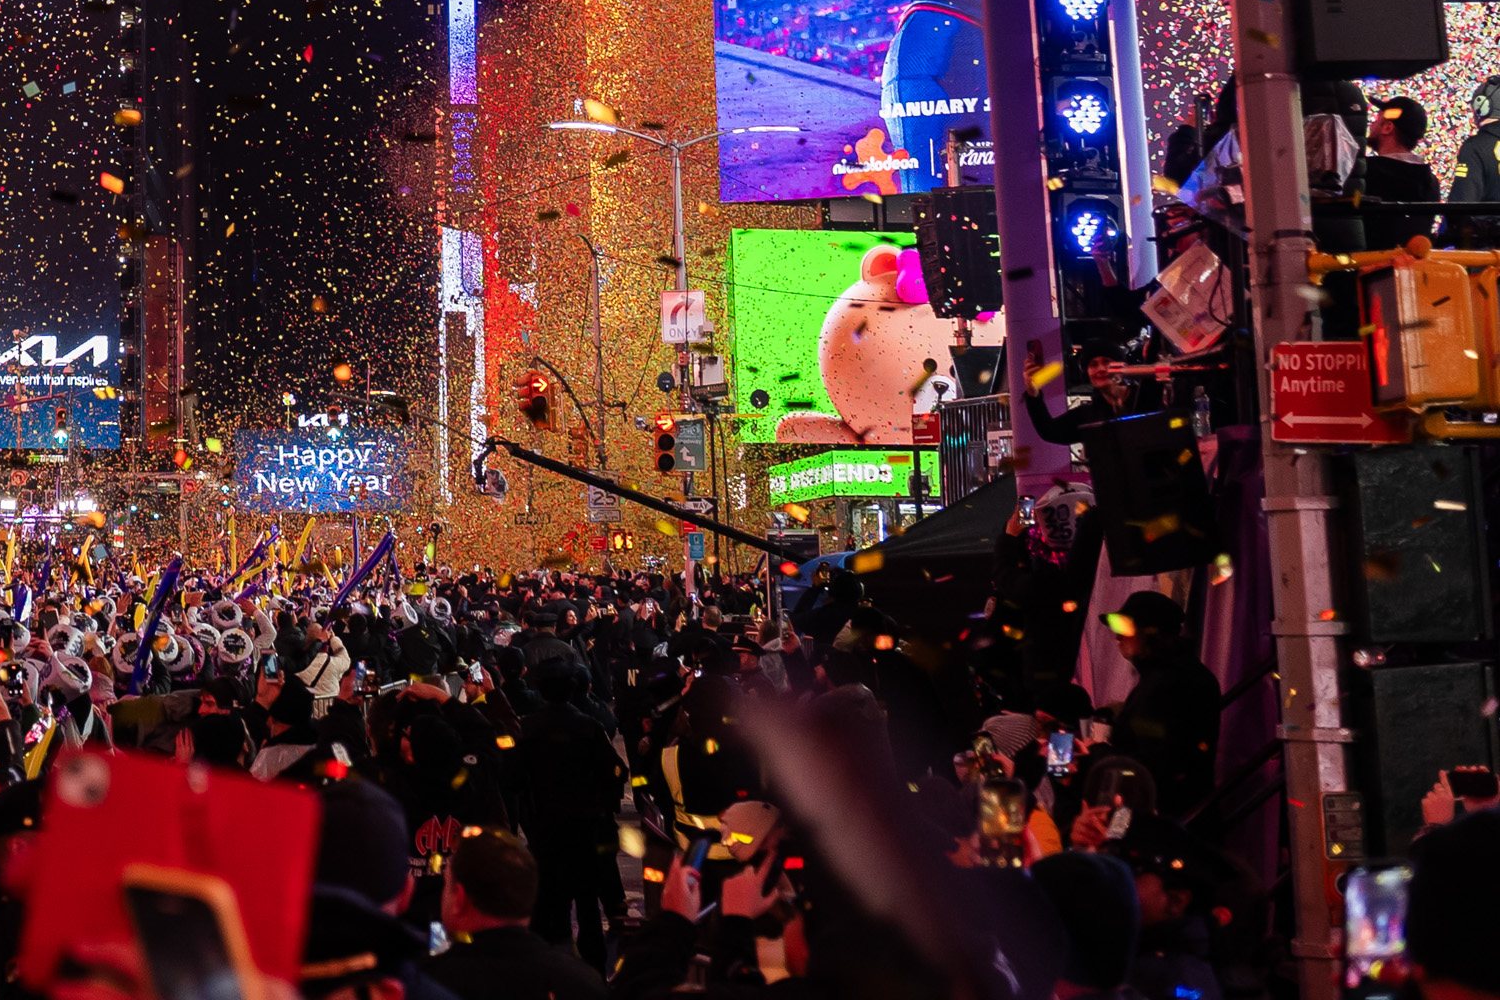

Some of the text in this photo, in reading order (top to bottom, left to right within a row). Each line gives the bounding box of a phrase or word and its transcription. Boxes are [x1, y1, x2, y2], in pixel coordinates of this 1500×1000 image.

[879, 97, 978, 119] JANUARY
[668, 328, 699, 339] ONLY
[1278, 353, 1367, 371] NO STOPPI
[43, 374, 64, 386] that
[67, 374, 108, 388] inspires
[1280, 376, 1345, 394] Anytime
[278, 445, 370, 470] Happy
[256, 471, 392, 493] New Year
[593, 491, 616, 506] 25
[692, 502, 709, 510] WAY
